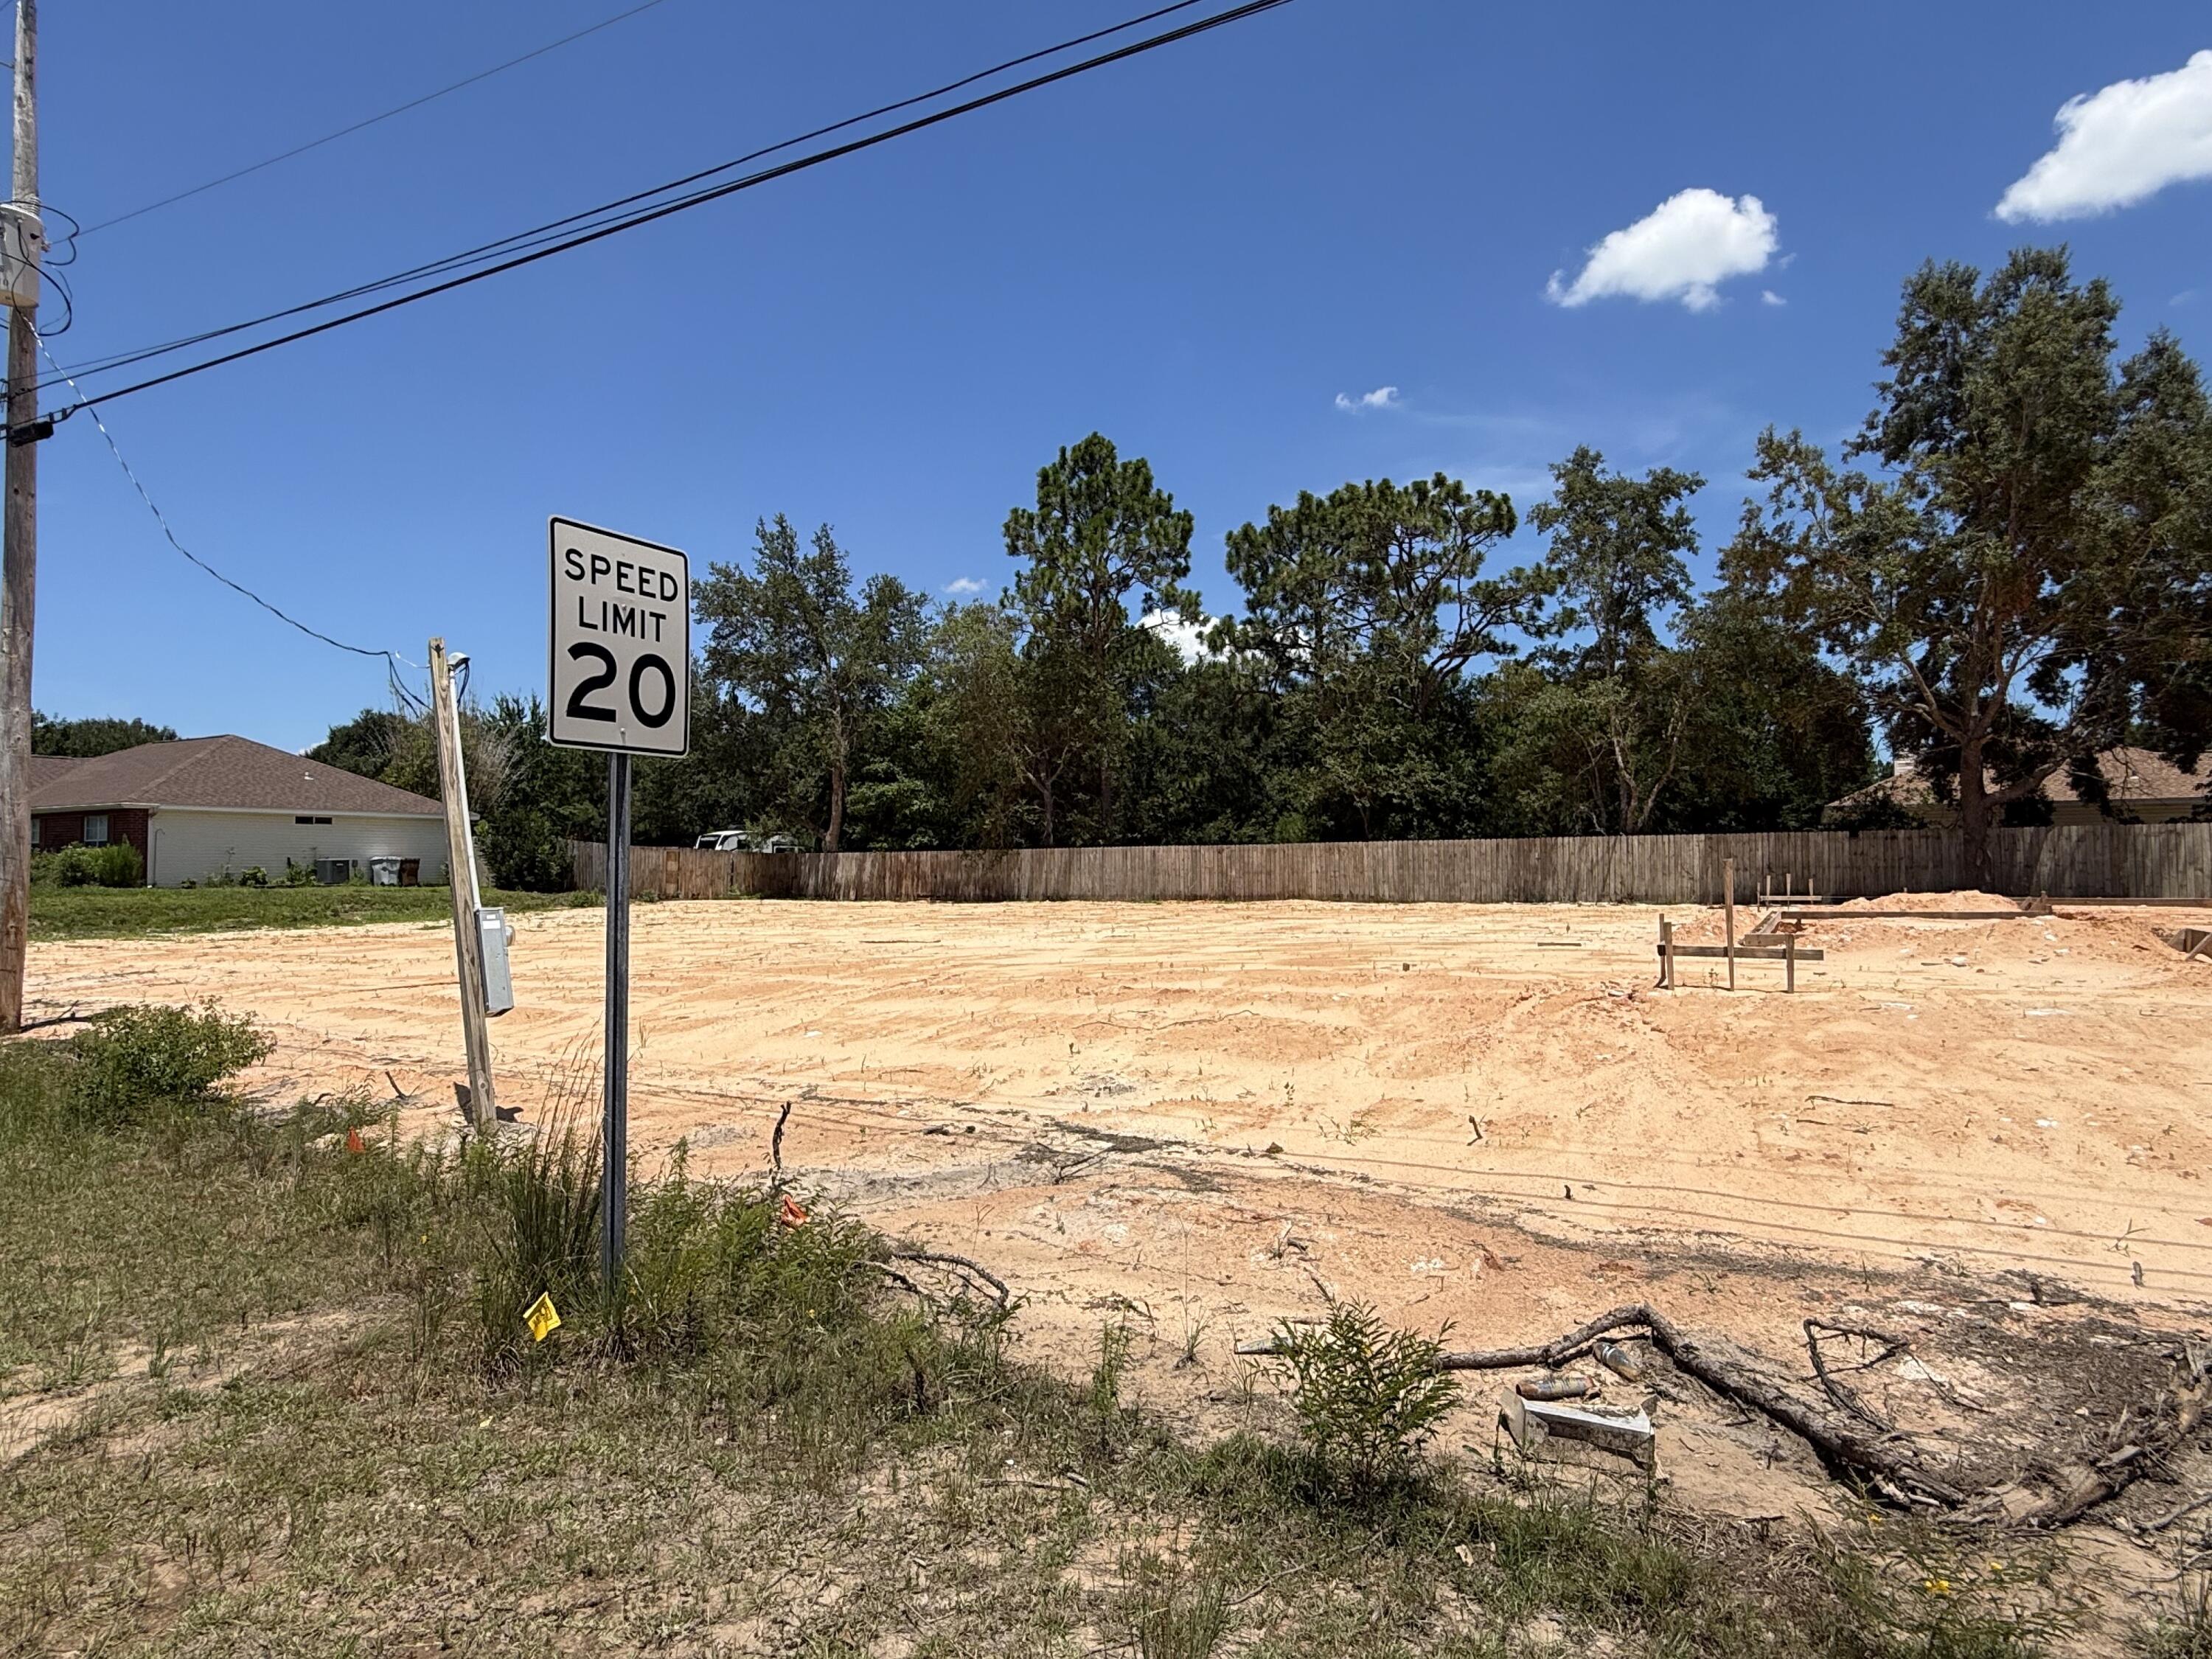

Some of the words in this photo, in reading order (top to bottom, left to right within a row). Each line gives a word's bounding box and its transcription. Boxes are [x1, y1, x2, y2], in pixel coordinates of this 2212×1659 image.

[565, 548, 678, 602] SPEED
[579, 596, 667, 642] LIMIT
[566, 641, 676, 728] 20
